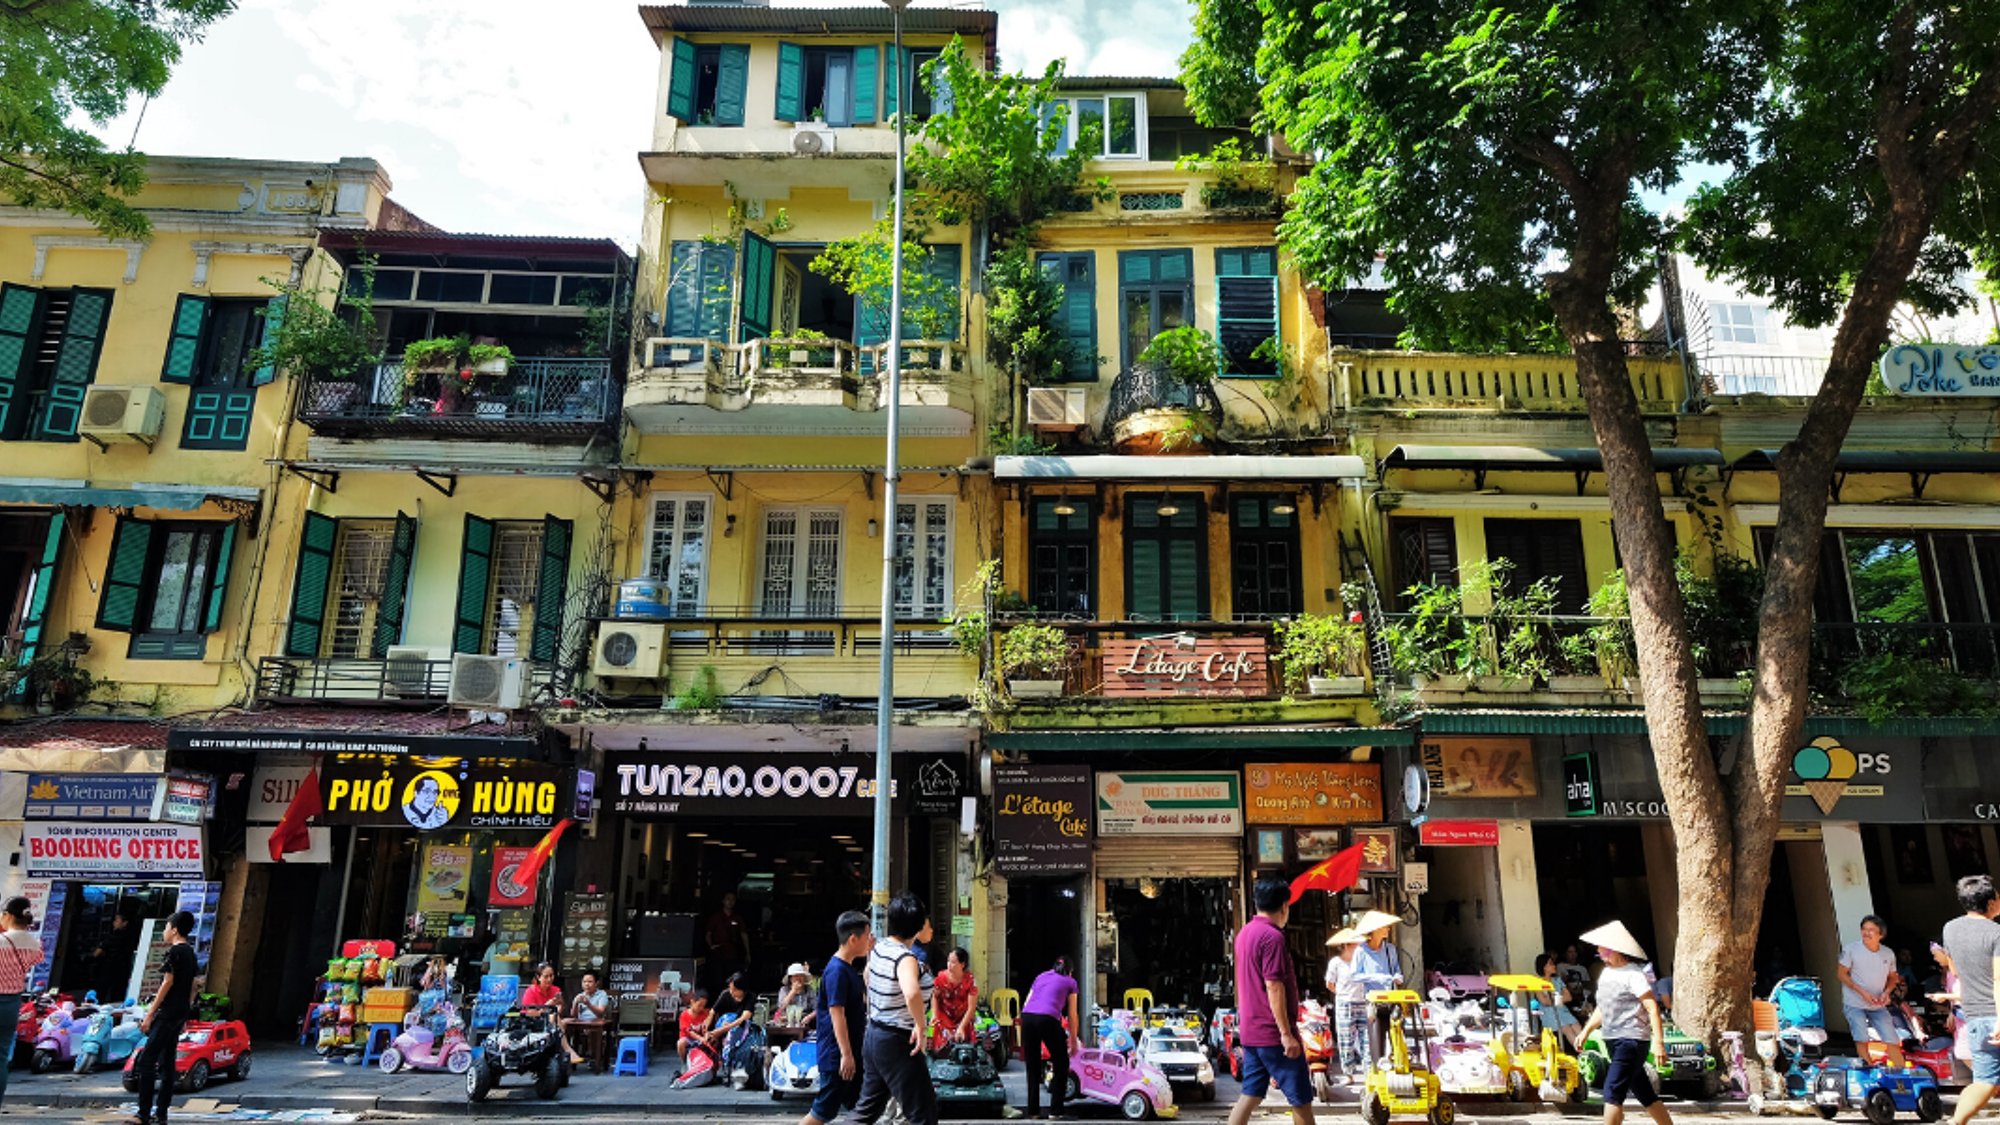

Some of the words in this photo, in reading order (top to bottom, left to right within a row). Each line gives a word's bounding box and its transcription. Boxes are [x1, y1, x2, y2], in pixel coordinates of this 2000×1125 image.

[1893, 345, 1963, 392] Poke
[64, 785, 127, 800] Vietnam
[328, 770, 394, 812] PHỞ
[473, 776, 556, 814] HÙNG
[856, 779, 898, 798] CAE
[1567, 773, 1591, 800] aha
[658, 802, 680, 812] KHAY
[998, 793, 1075, 822] L'étage
[1256, 796, 1289, 811] Quang
[1974, 803, 2000, 820] CA
[470, 815, 515, 826] CHÍNH
[47, 827, 72, 835] TOUR
[75, 827, 140, 836] INFORMATION
[143, 828, 177, 837] CENTER
[30, 838, 121, 859] BOOKING
[128, 839, 200, 859] OFFICE
